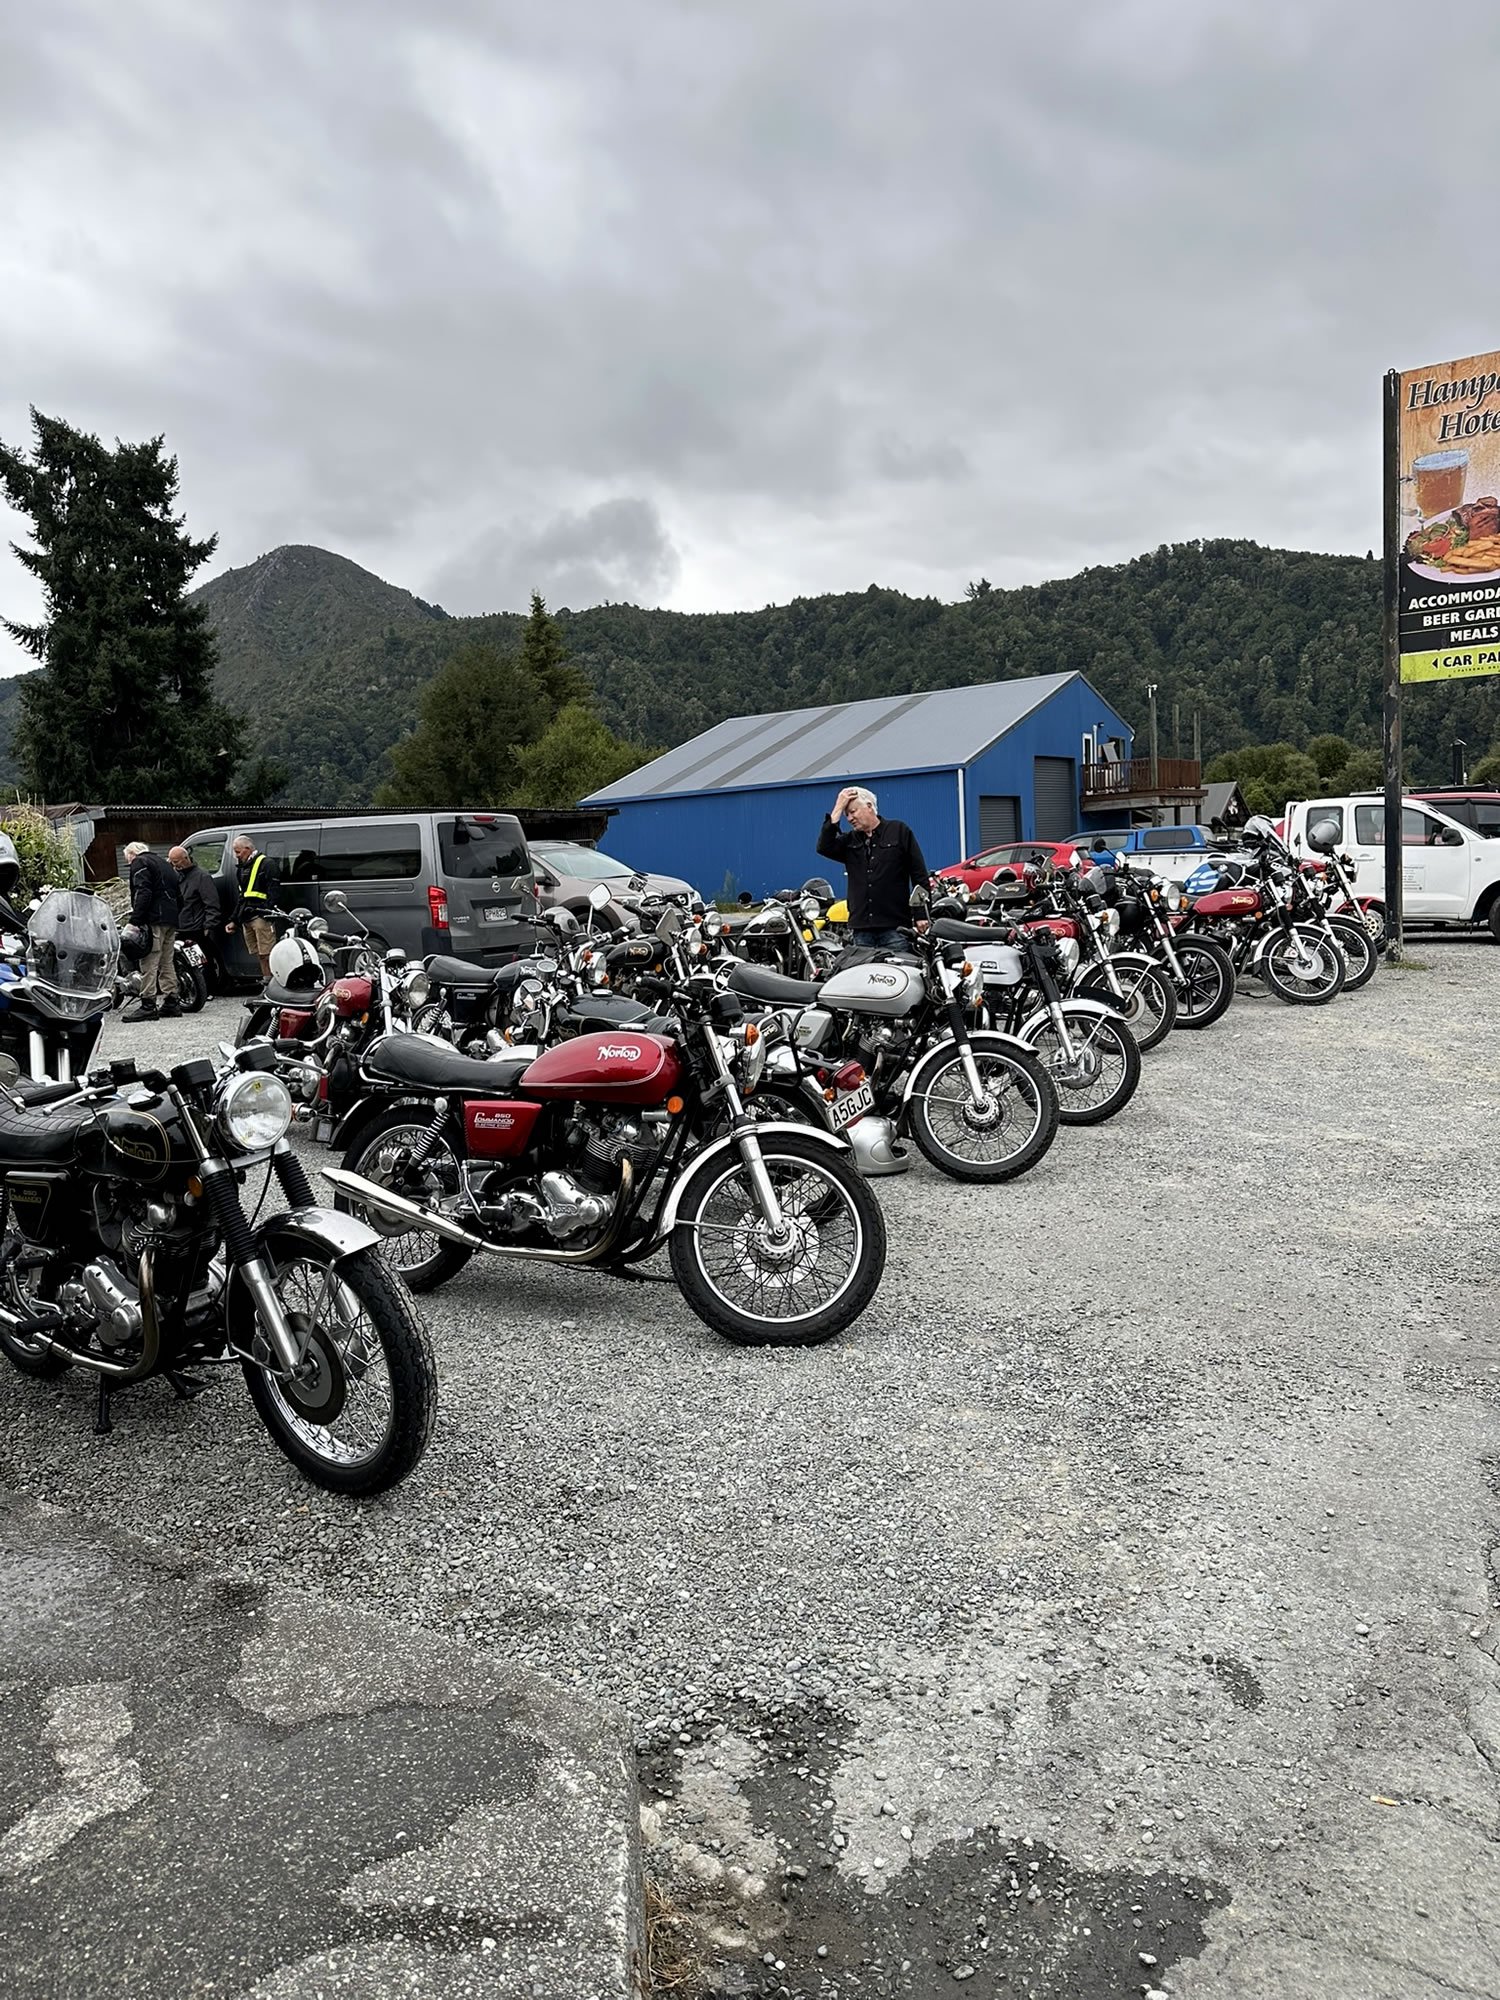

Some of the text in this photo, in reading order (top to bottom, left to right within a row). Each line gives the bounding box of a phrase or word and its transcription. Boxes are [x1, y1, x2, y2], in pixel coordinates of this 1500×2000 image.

[1423, 612, 1460, 627] BEER
[1450, 626, 1499, 642] MEALS
[1443, 651, 1500, 667] CAR PA
[868, 973, 896, 986] Norton
[597, 1044, 642, 1061] Norton
[832, 1087, 872, 1128] A5GJC
